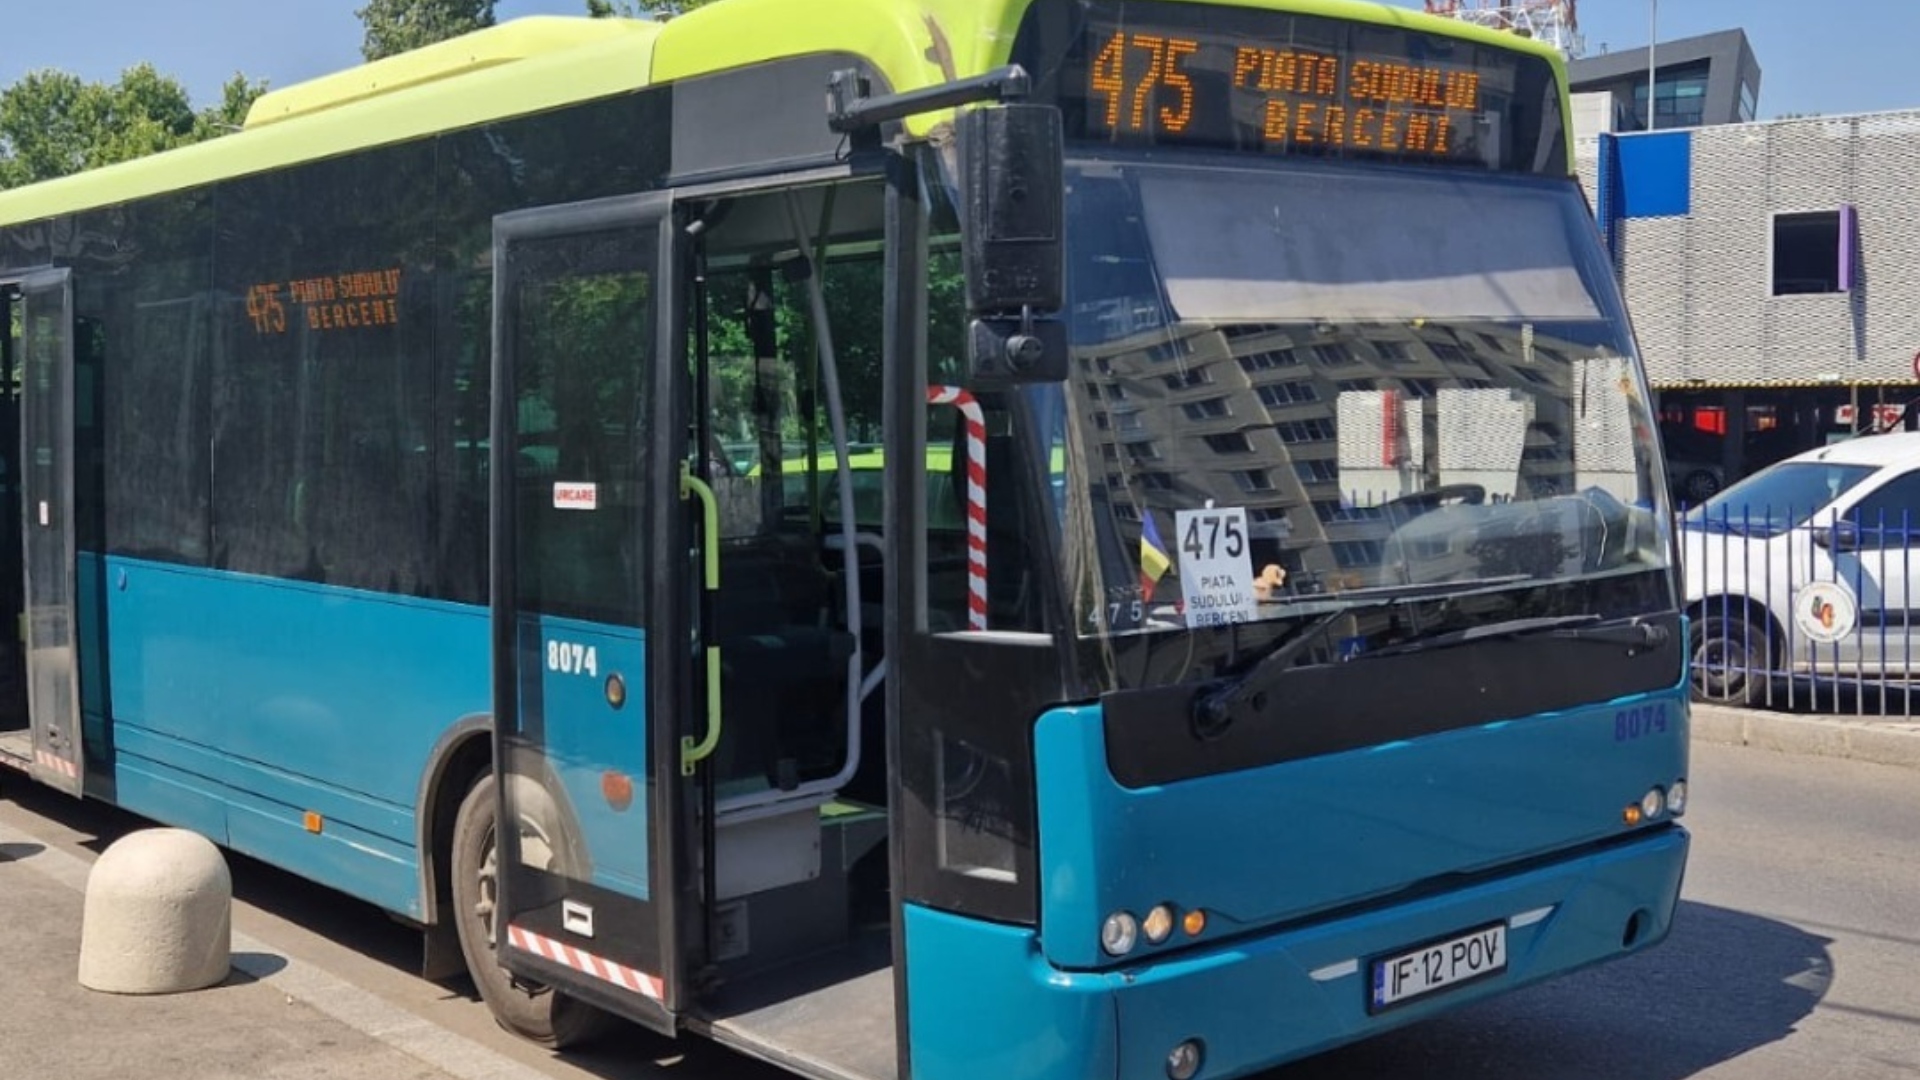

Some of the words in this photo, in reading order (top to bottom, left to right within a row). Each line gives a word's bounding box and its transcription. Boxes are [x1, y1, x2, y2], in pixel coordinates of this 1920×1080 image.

[1092, 32, 1197, 132] 475
[1234, 48, 1337, 95] PIATA
[1264, 101, 1450, 153] BERCENI
[247, 283, 286, 334] 475
[307, 299, 398, 329] BERCENI
[555, 489, 594, 501] URCARE
[1183, 515, 1243, 560] 475
[1201, 574, 1235, 589] PIATA
[547, 640, 598, 677] 8074
[1615, 702, 1666, 742] 8074
[1452, 931, 1499, 977] POV
